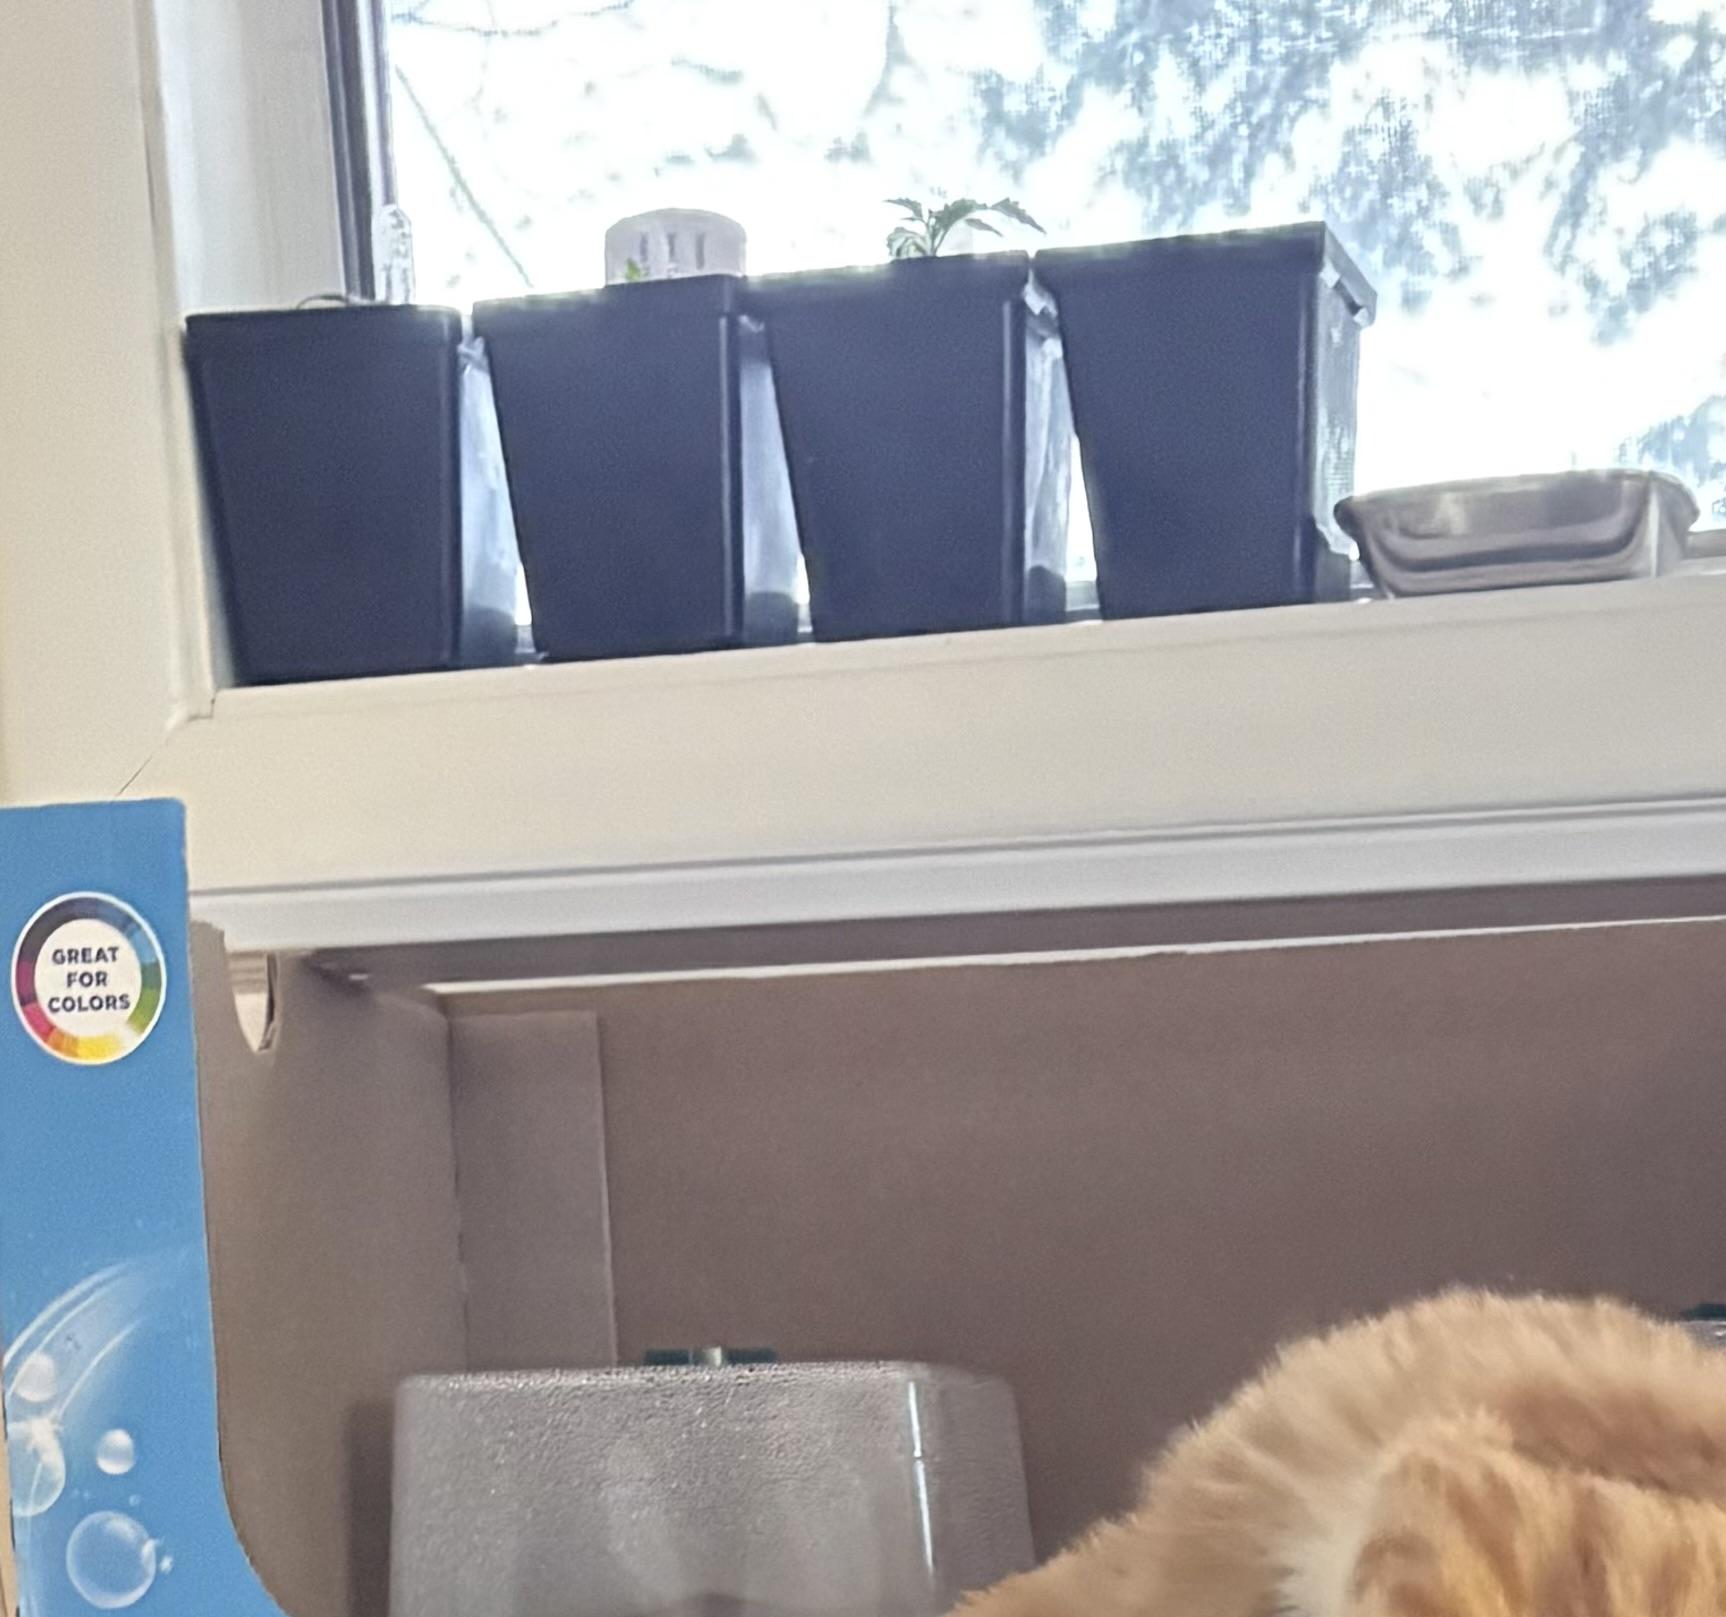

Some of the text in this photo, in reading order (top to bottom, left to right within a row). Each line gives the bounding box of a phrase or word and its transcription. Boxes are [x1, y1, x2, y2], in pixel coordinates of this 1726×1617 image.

[52, 947, 119, 964] GREAT
[66, 971, 107, 988] FOR
[48, 993, 130, 1013] COLORS
